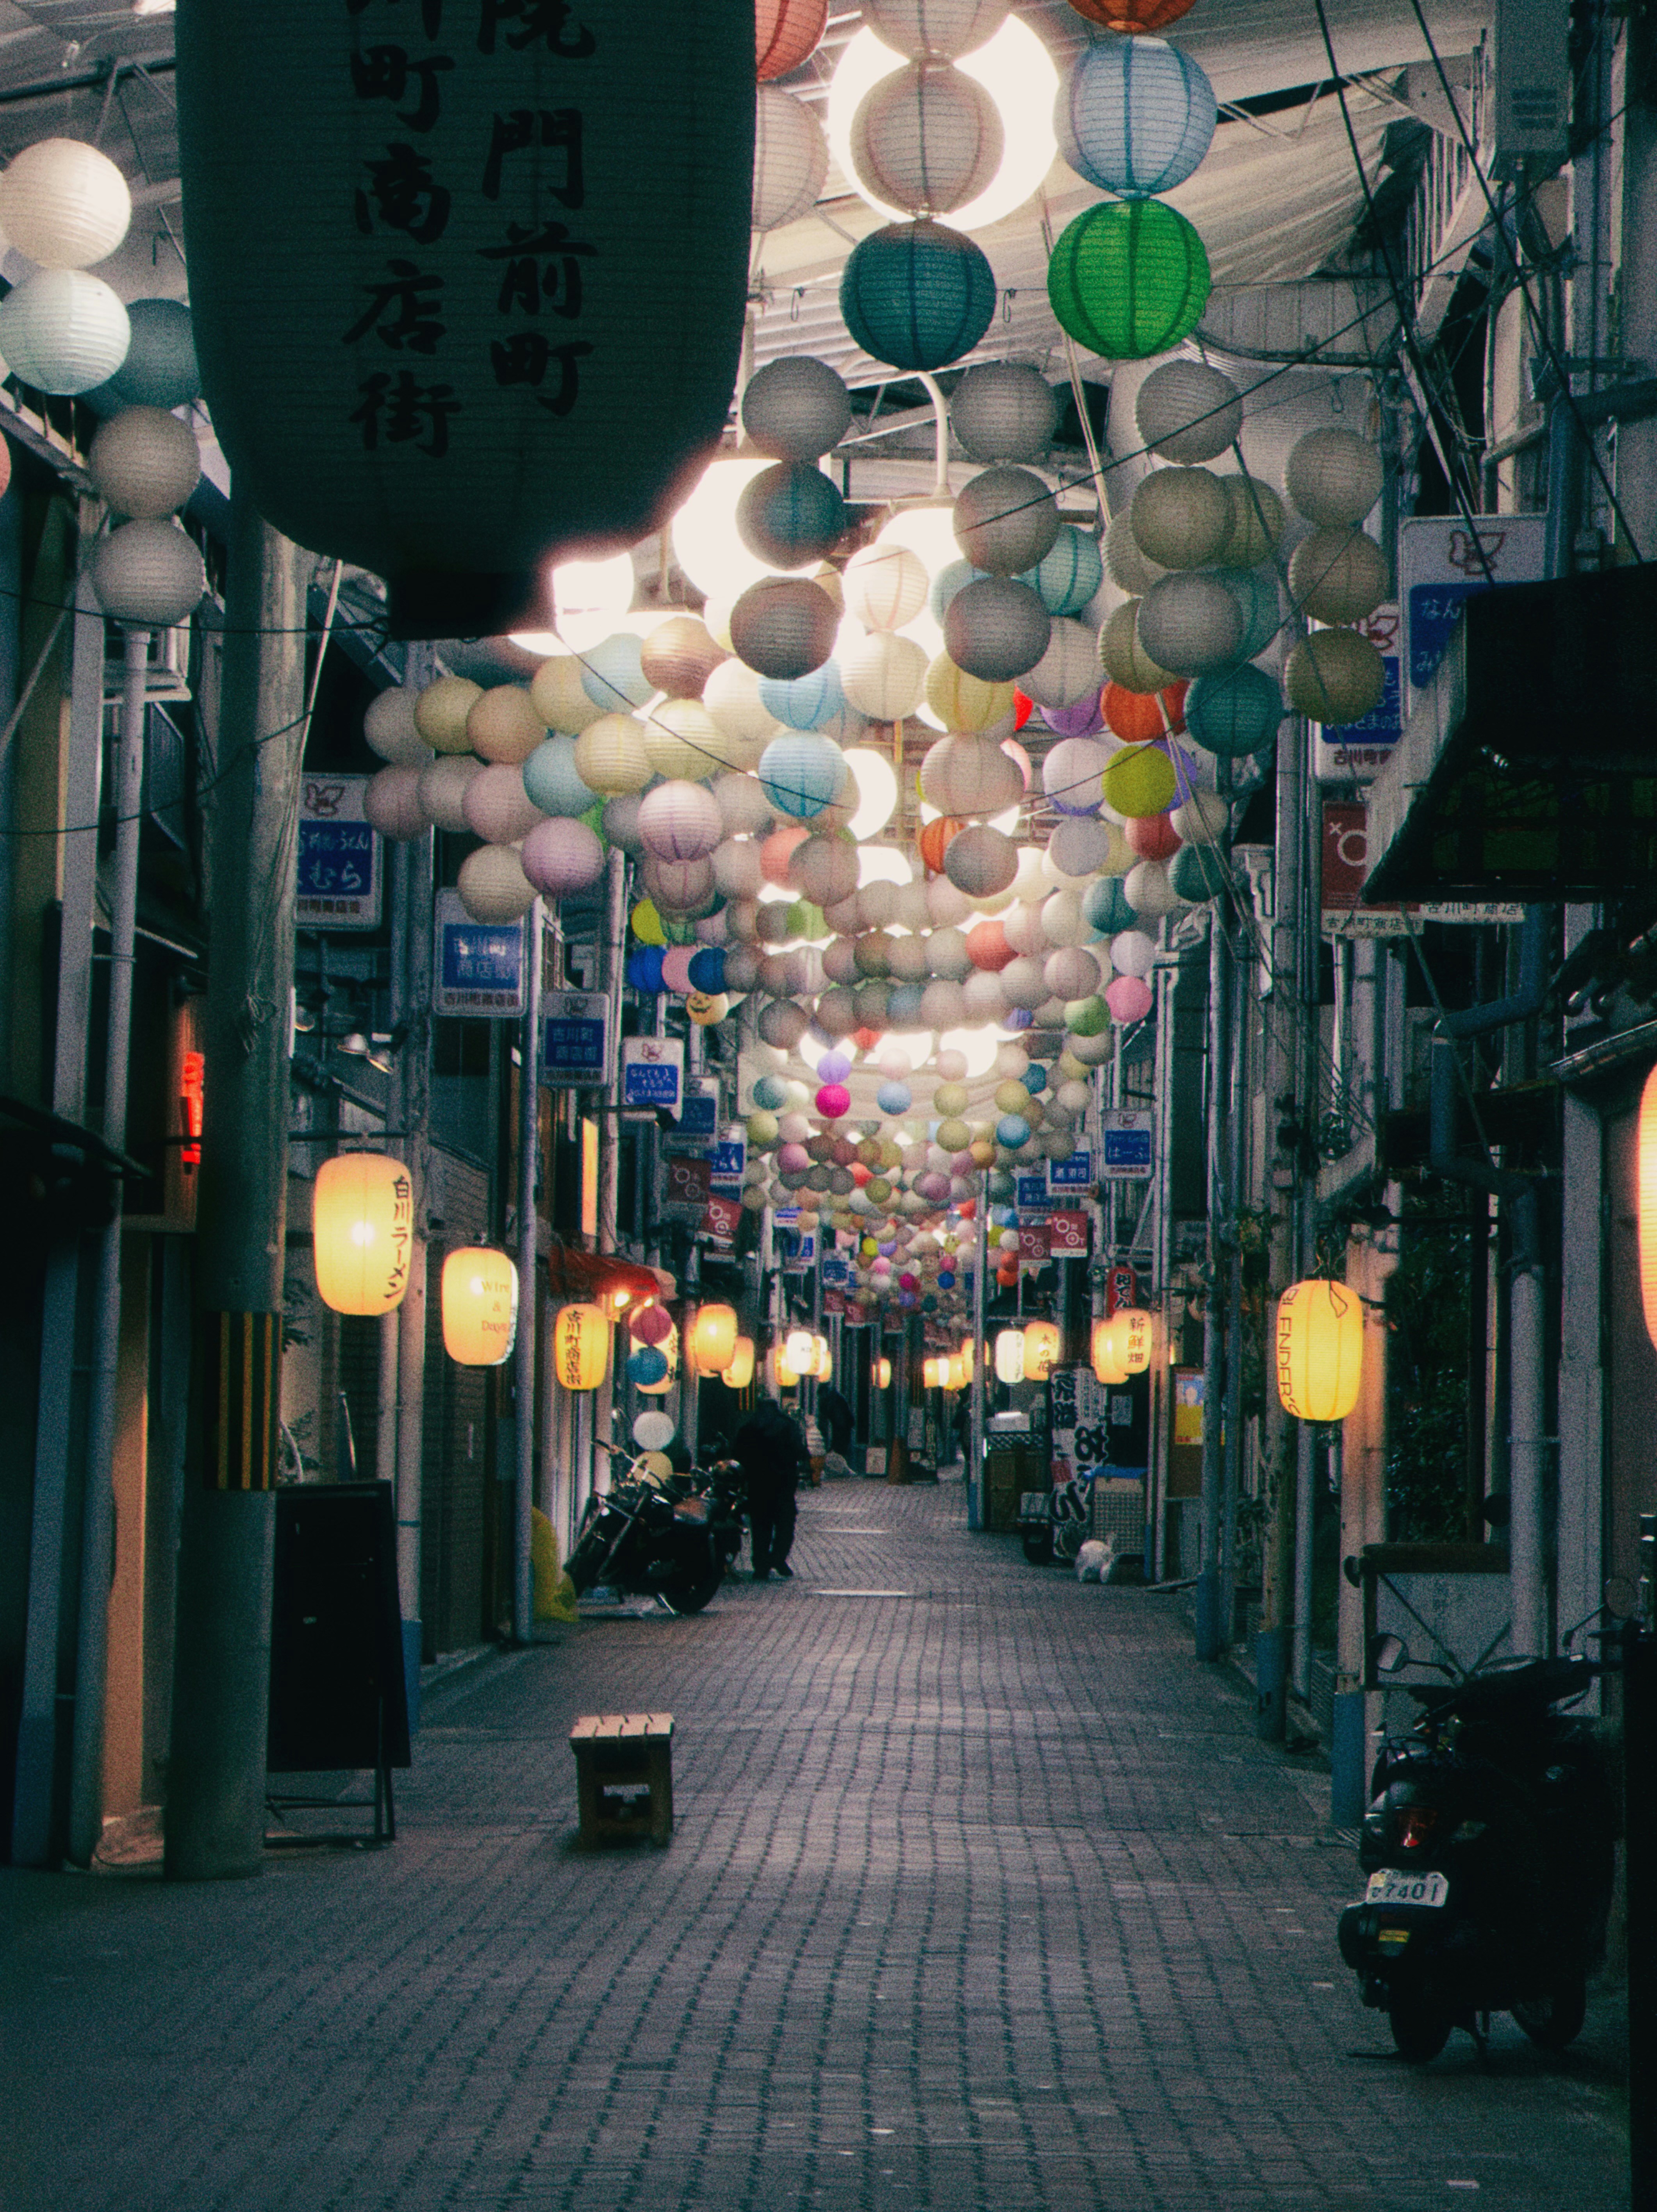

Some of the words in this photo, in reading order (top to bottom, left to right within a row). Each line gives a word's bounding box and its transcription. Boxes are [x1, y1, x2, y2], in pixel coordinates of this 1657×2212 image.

[384, 1174, 410, 1299] 白川ラーメン
